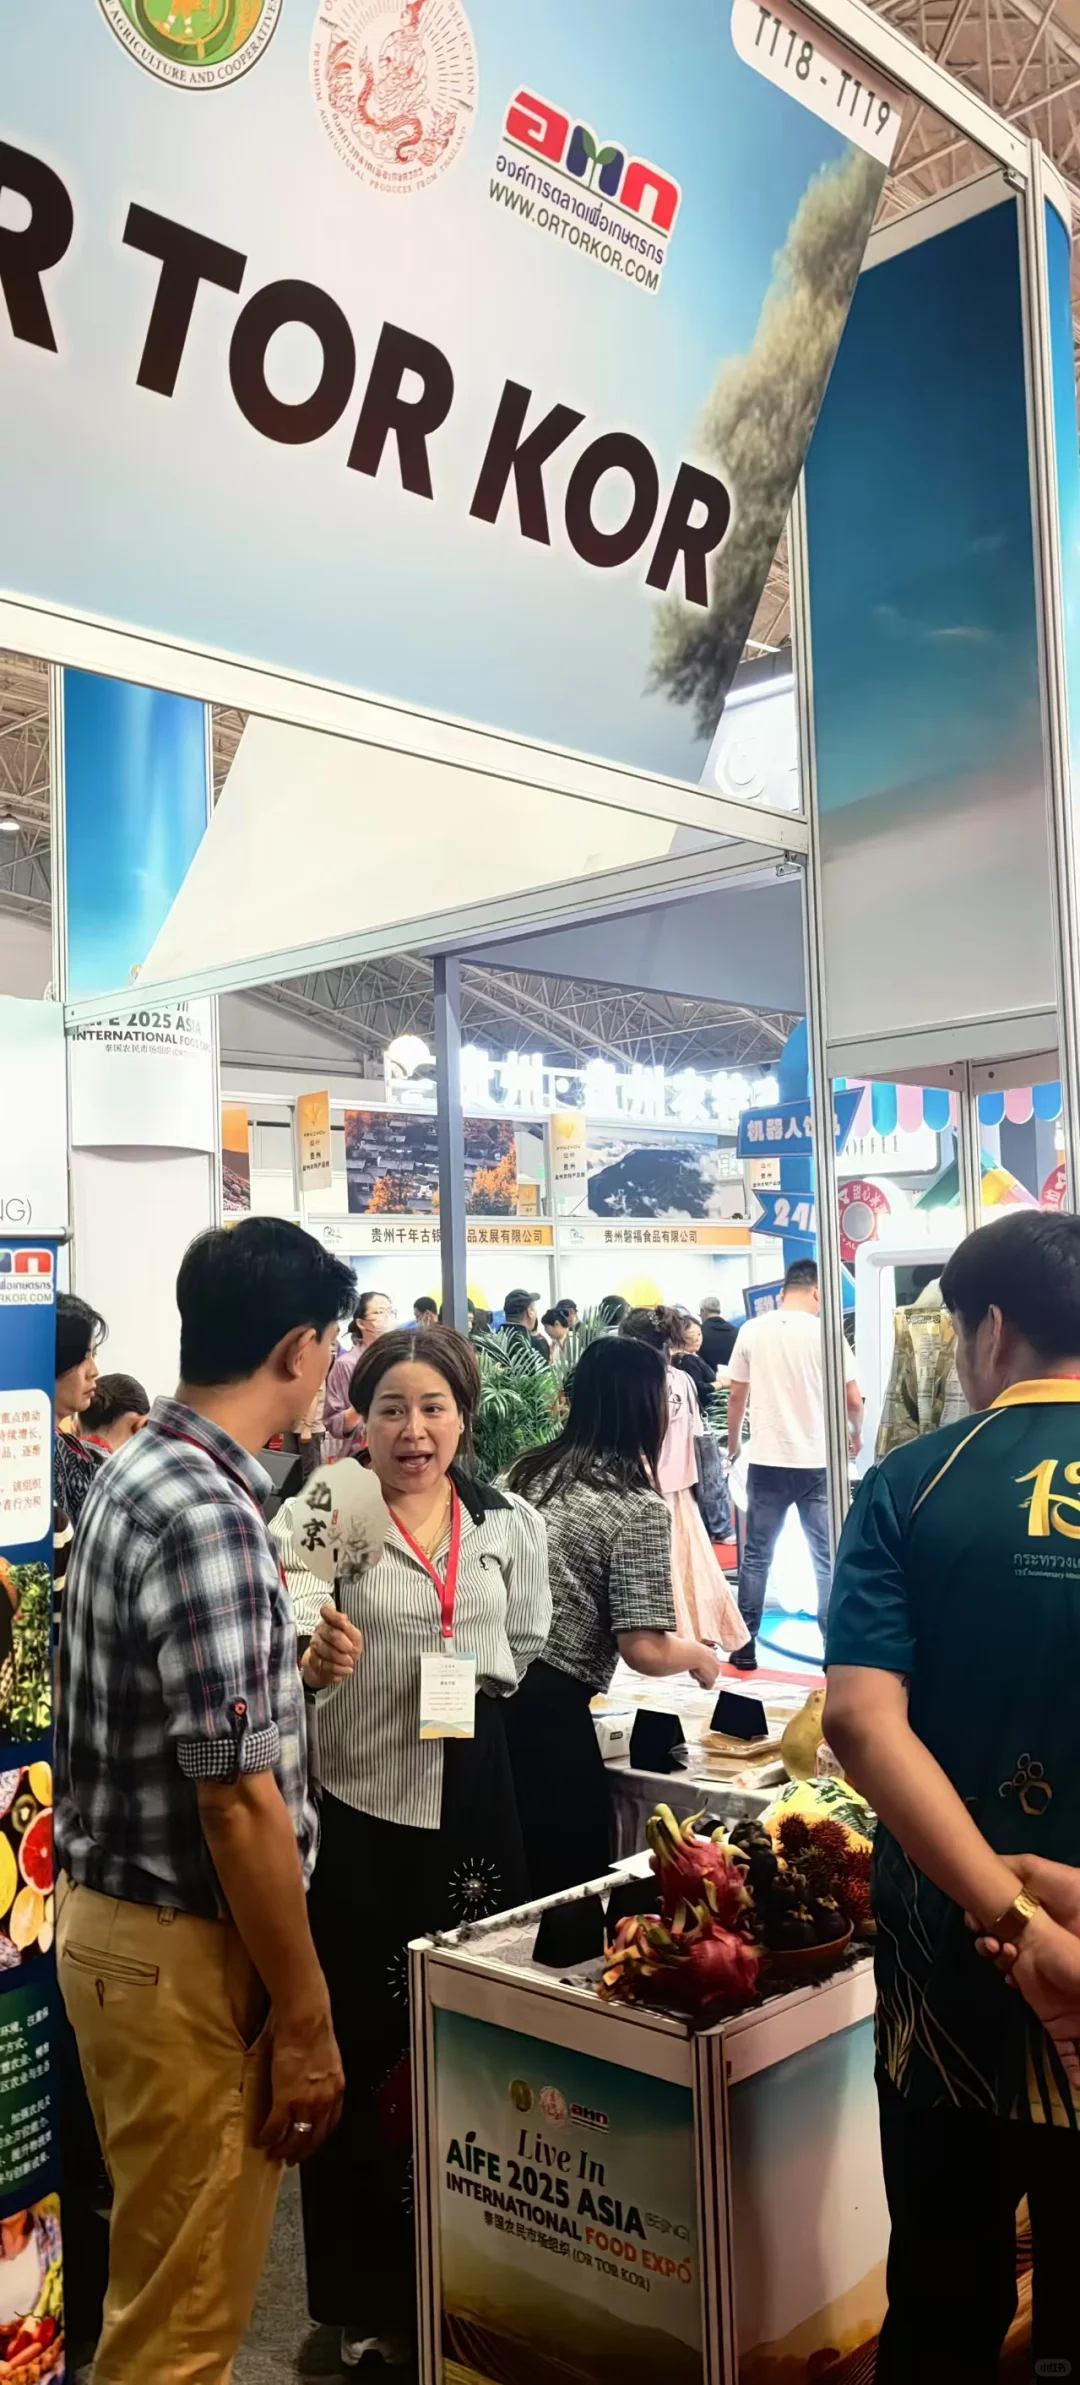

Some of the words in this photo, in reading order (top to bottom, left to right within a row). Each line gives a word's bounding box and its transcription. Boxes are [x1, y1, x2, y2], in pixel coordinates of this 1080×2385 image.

[109, 10, 187, 82] AGRICULTURE
[189, 72, 215, 83] AND
[753, 10, 815, 81] T118
[836, 69, 891, 137] T119
[489, 179, 659, 290] WWW.ORTORKOR.COM
[496, 155, 664, 264] องค์การตลาดเพื่อเกษตรกร
[122, 202, 455, 500] TOR
[469, 379, 731, 608] KOR
[72, 1031, 178, 1045] INTERNATIONAL
[371, 1227, 544, 1245] 贵州千年古银品发展有限公司
[506, 2160, 570, 2208] 2025
[577, 2188, 647, 2240] ASIA
[517, 2129, 572, 2173] Live
[577, 2150, 606, 2187] In
[446, 2171, 582, 2242] INTERNATIONAL
[585, 2226, 637, 2262] FOOD
[641, 2250, 692, 2284] EXPO
